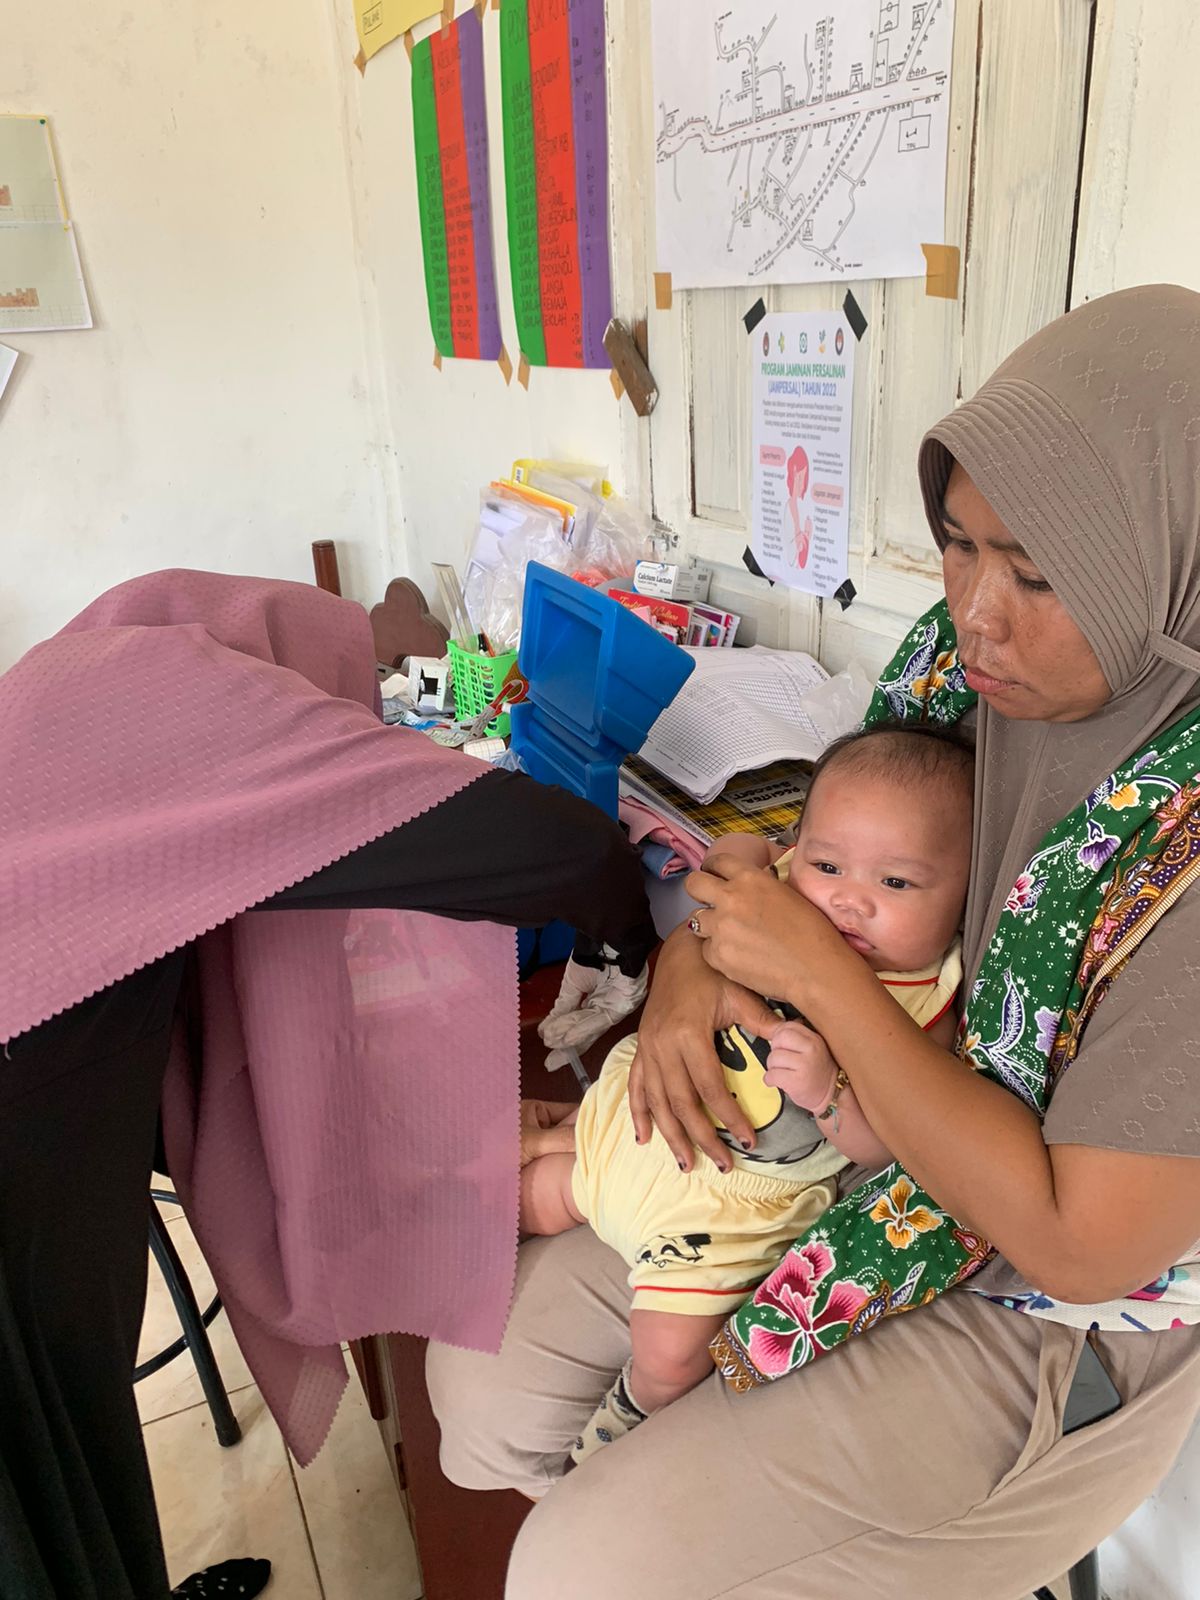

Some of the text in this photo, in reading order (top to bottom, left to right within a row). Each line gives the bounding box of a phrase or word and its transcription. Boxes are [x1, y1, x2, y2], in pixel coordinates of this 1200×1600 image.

[761, 362, 846, 379] PROGRAM JAMINAN PERSALINAN
[802, 381, 821, 396] TAHUN
[822, 383, 837, 397] 2022
[638, 572, 656, 582] Calcium
[656, 576, 673, 585] Lactate
[741, 785, 801, 804] REGISTER
